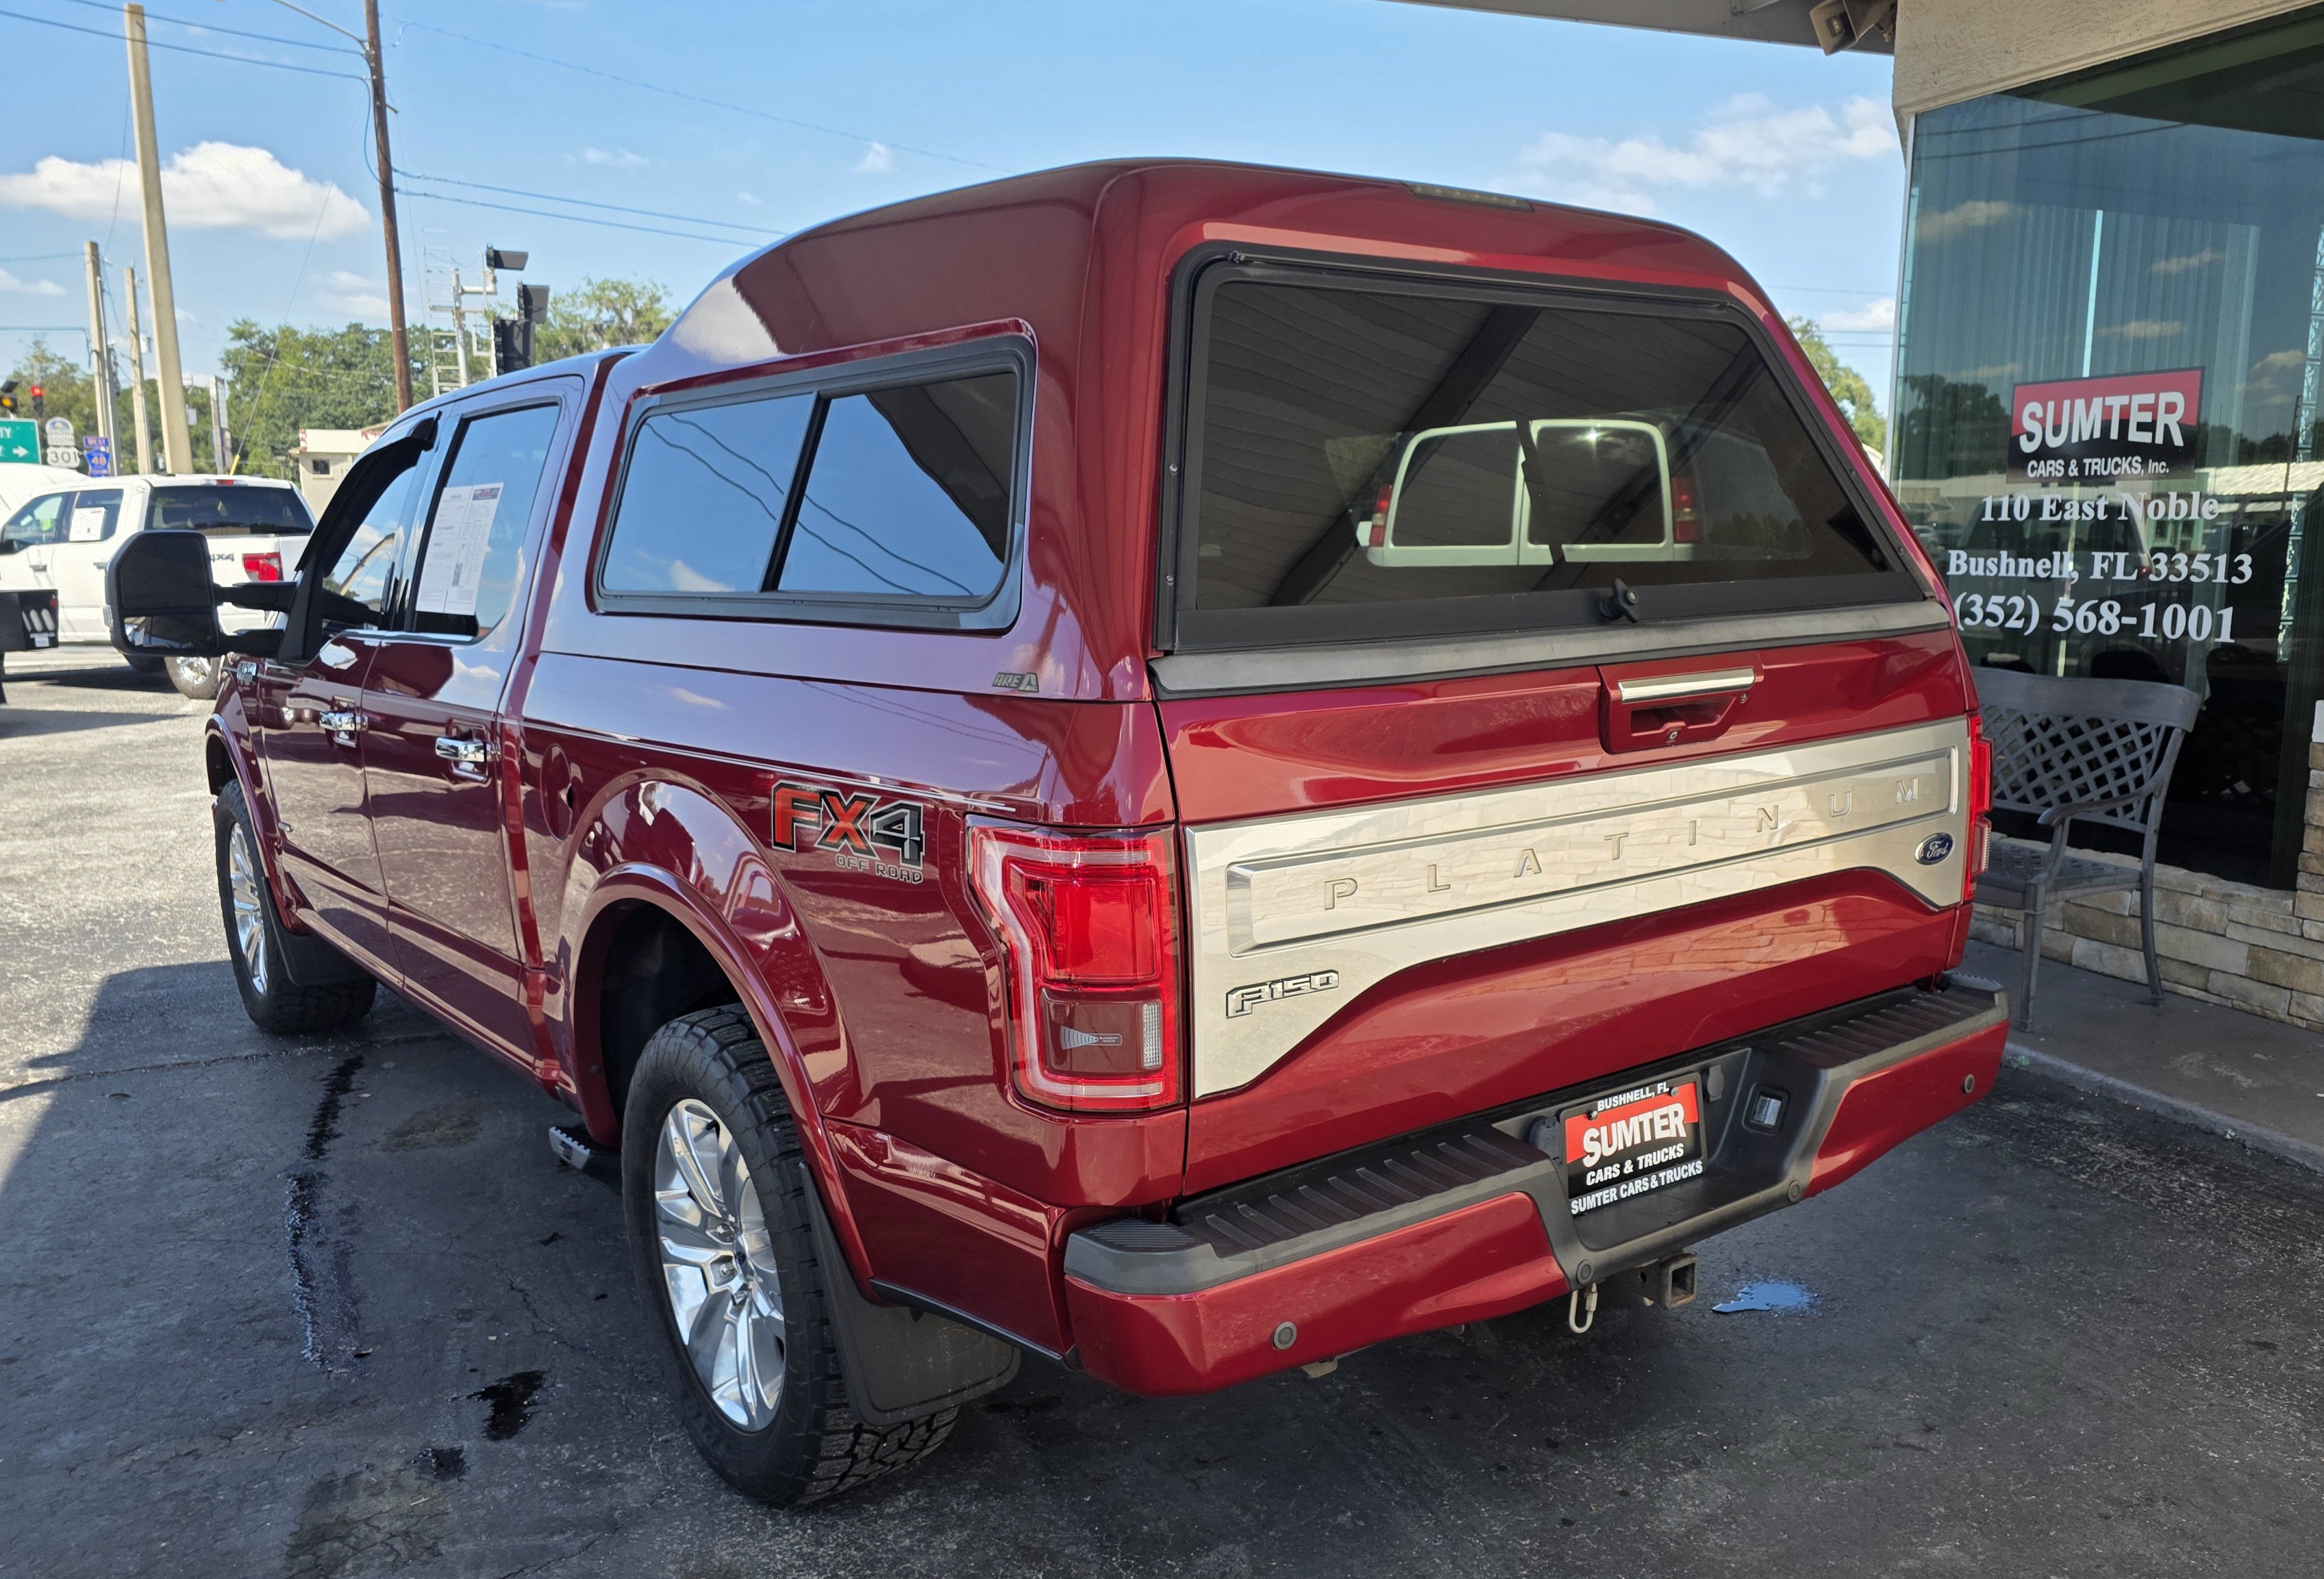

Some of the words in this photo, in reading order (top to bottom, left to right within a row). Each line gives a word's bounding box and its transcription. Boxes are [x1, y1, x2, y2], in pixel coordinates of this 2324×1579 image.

[2019, 391, 2185, 453] SUMTER
[50, 451, 77, 464] 301
[2027, 460, 2064, 478] CARS
[2068, 459, 2079, 477] &
[2083, 456, 2145, 476] TRUCKS,
[2148, 459, 2169, 474] Inc.
[1982, 494, 2030, 522] 110
[2039, 494, 2109, 521] East
[2117, 491, 2220, 521] Noble
[1947, 549, 2079, 584] Bushnell,
[2089, 551, 2138, 580] FL
[2149, 552, 2253, 584] 33513
[1954, 592, 2040, 636] (352)
[2052, 598, 2236, 644] 568-1001
[772, 780, 925, 870] FX4
[1323, 778, 1919, 911] PLATINUM
[836, 854, 870, 873] OFF
[875, 861, 924, 884] ROAD
[1597, 1086, 1655, 1112] BUSHNELL,
[1657, 1081, 1670, 1094] FL
[1582, 1102, 1687, 1168] SUMTER
[1586, 1163, 1621, 1186] CARS
[1623, 1159, 1634, 1174] &
[1637, 1143, 1684, 1170] TRUCKS
[1571, 1187, 1619, 1215] SUMTER
[1619, 1176, 1650, 1199] CARS
[1650, 1174, 1659, 1189] &
[1659, 1160, 1703, 1186] TRUCKS
